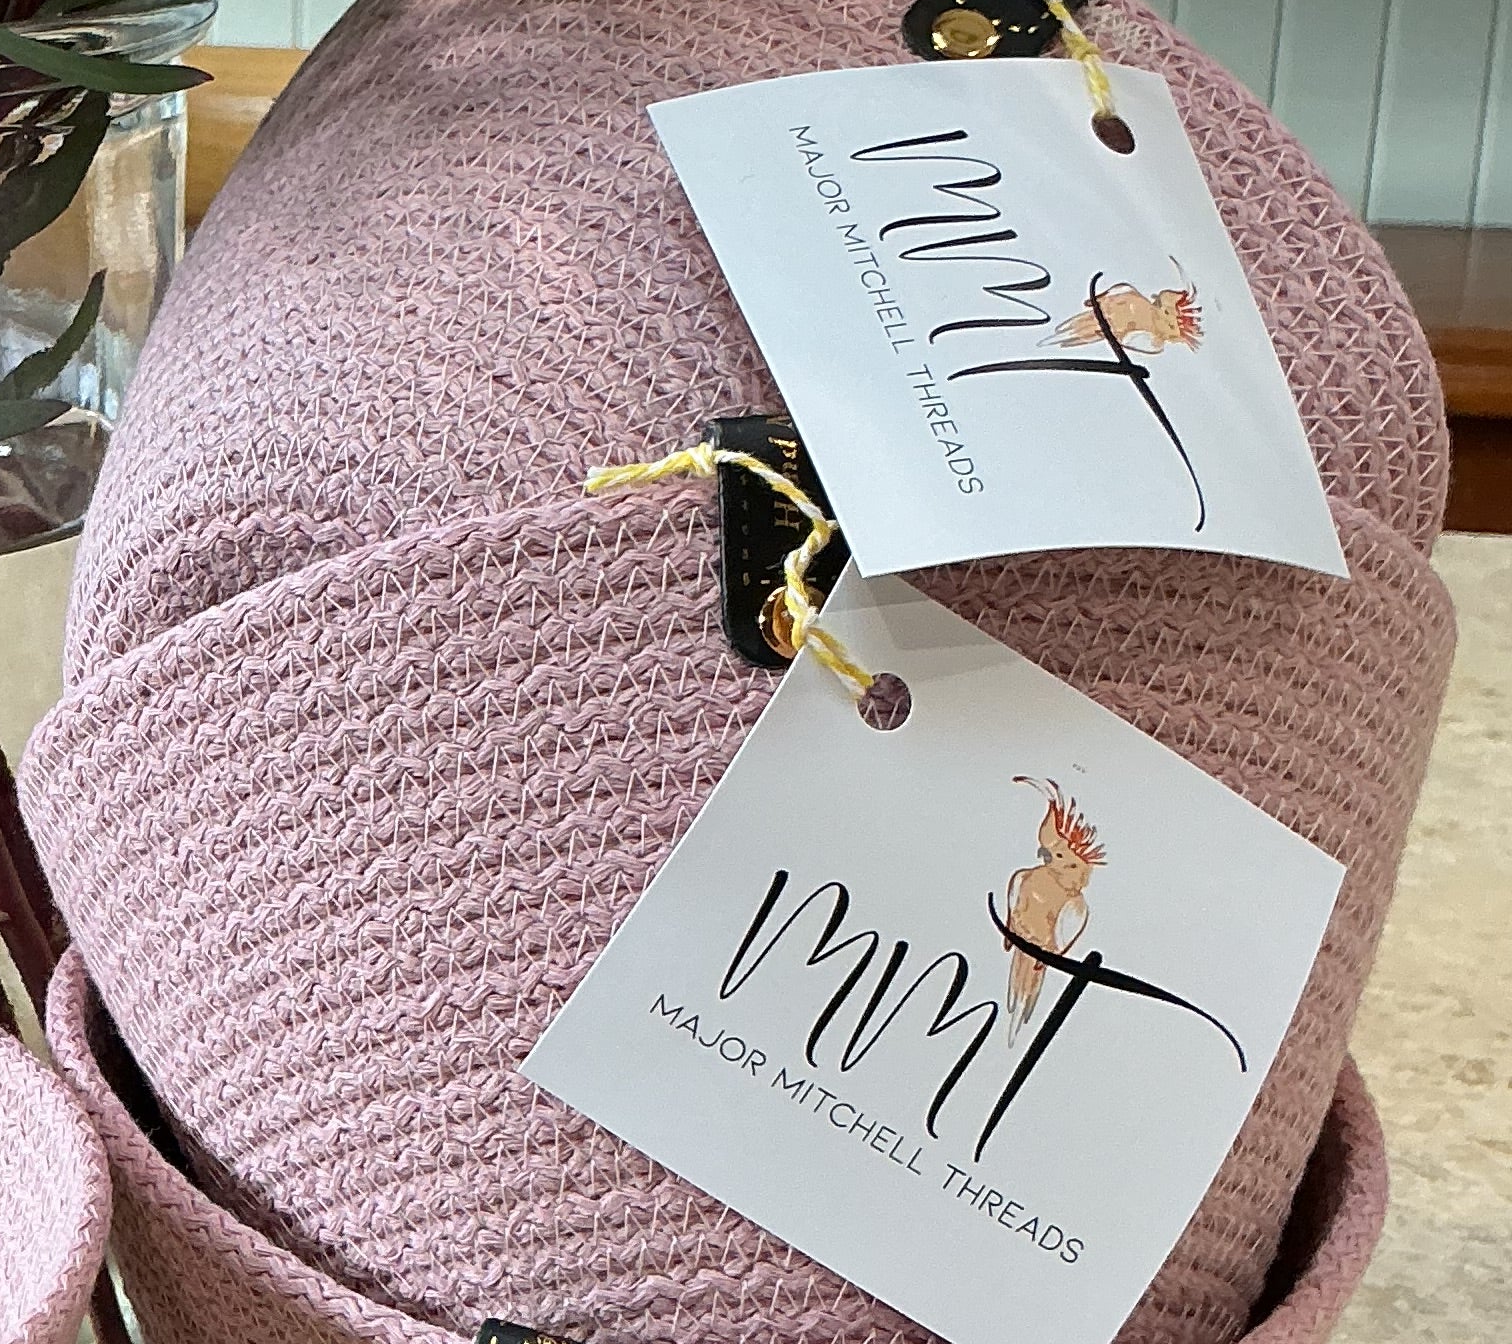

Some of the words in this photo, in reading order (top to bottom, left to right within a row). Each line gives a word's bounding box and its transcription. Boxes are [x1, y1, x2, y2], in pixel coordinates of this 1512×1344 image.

[789, 126, 850, 214] MAJOR
[836, 224, 906, 354] MITCHELL
[907, 364, 984, 493] THREADS
[767, 436, 802, 532] Hnd
[650, 994, 766, 1076] MAJOR
[771, 1067, 922, 1175] MITCHELL
[943, 1163, 1084, 1263] THREADS
